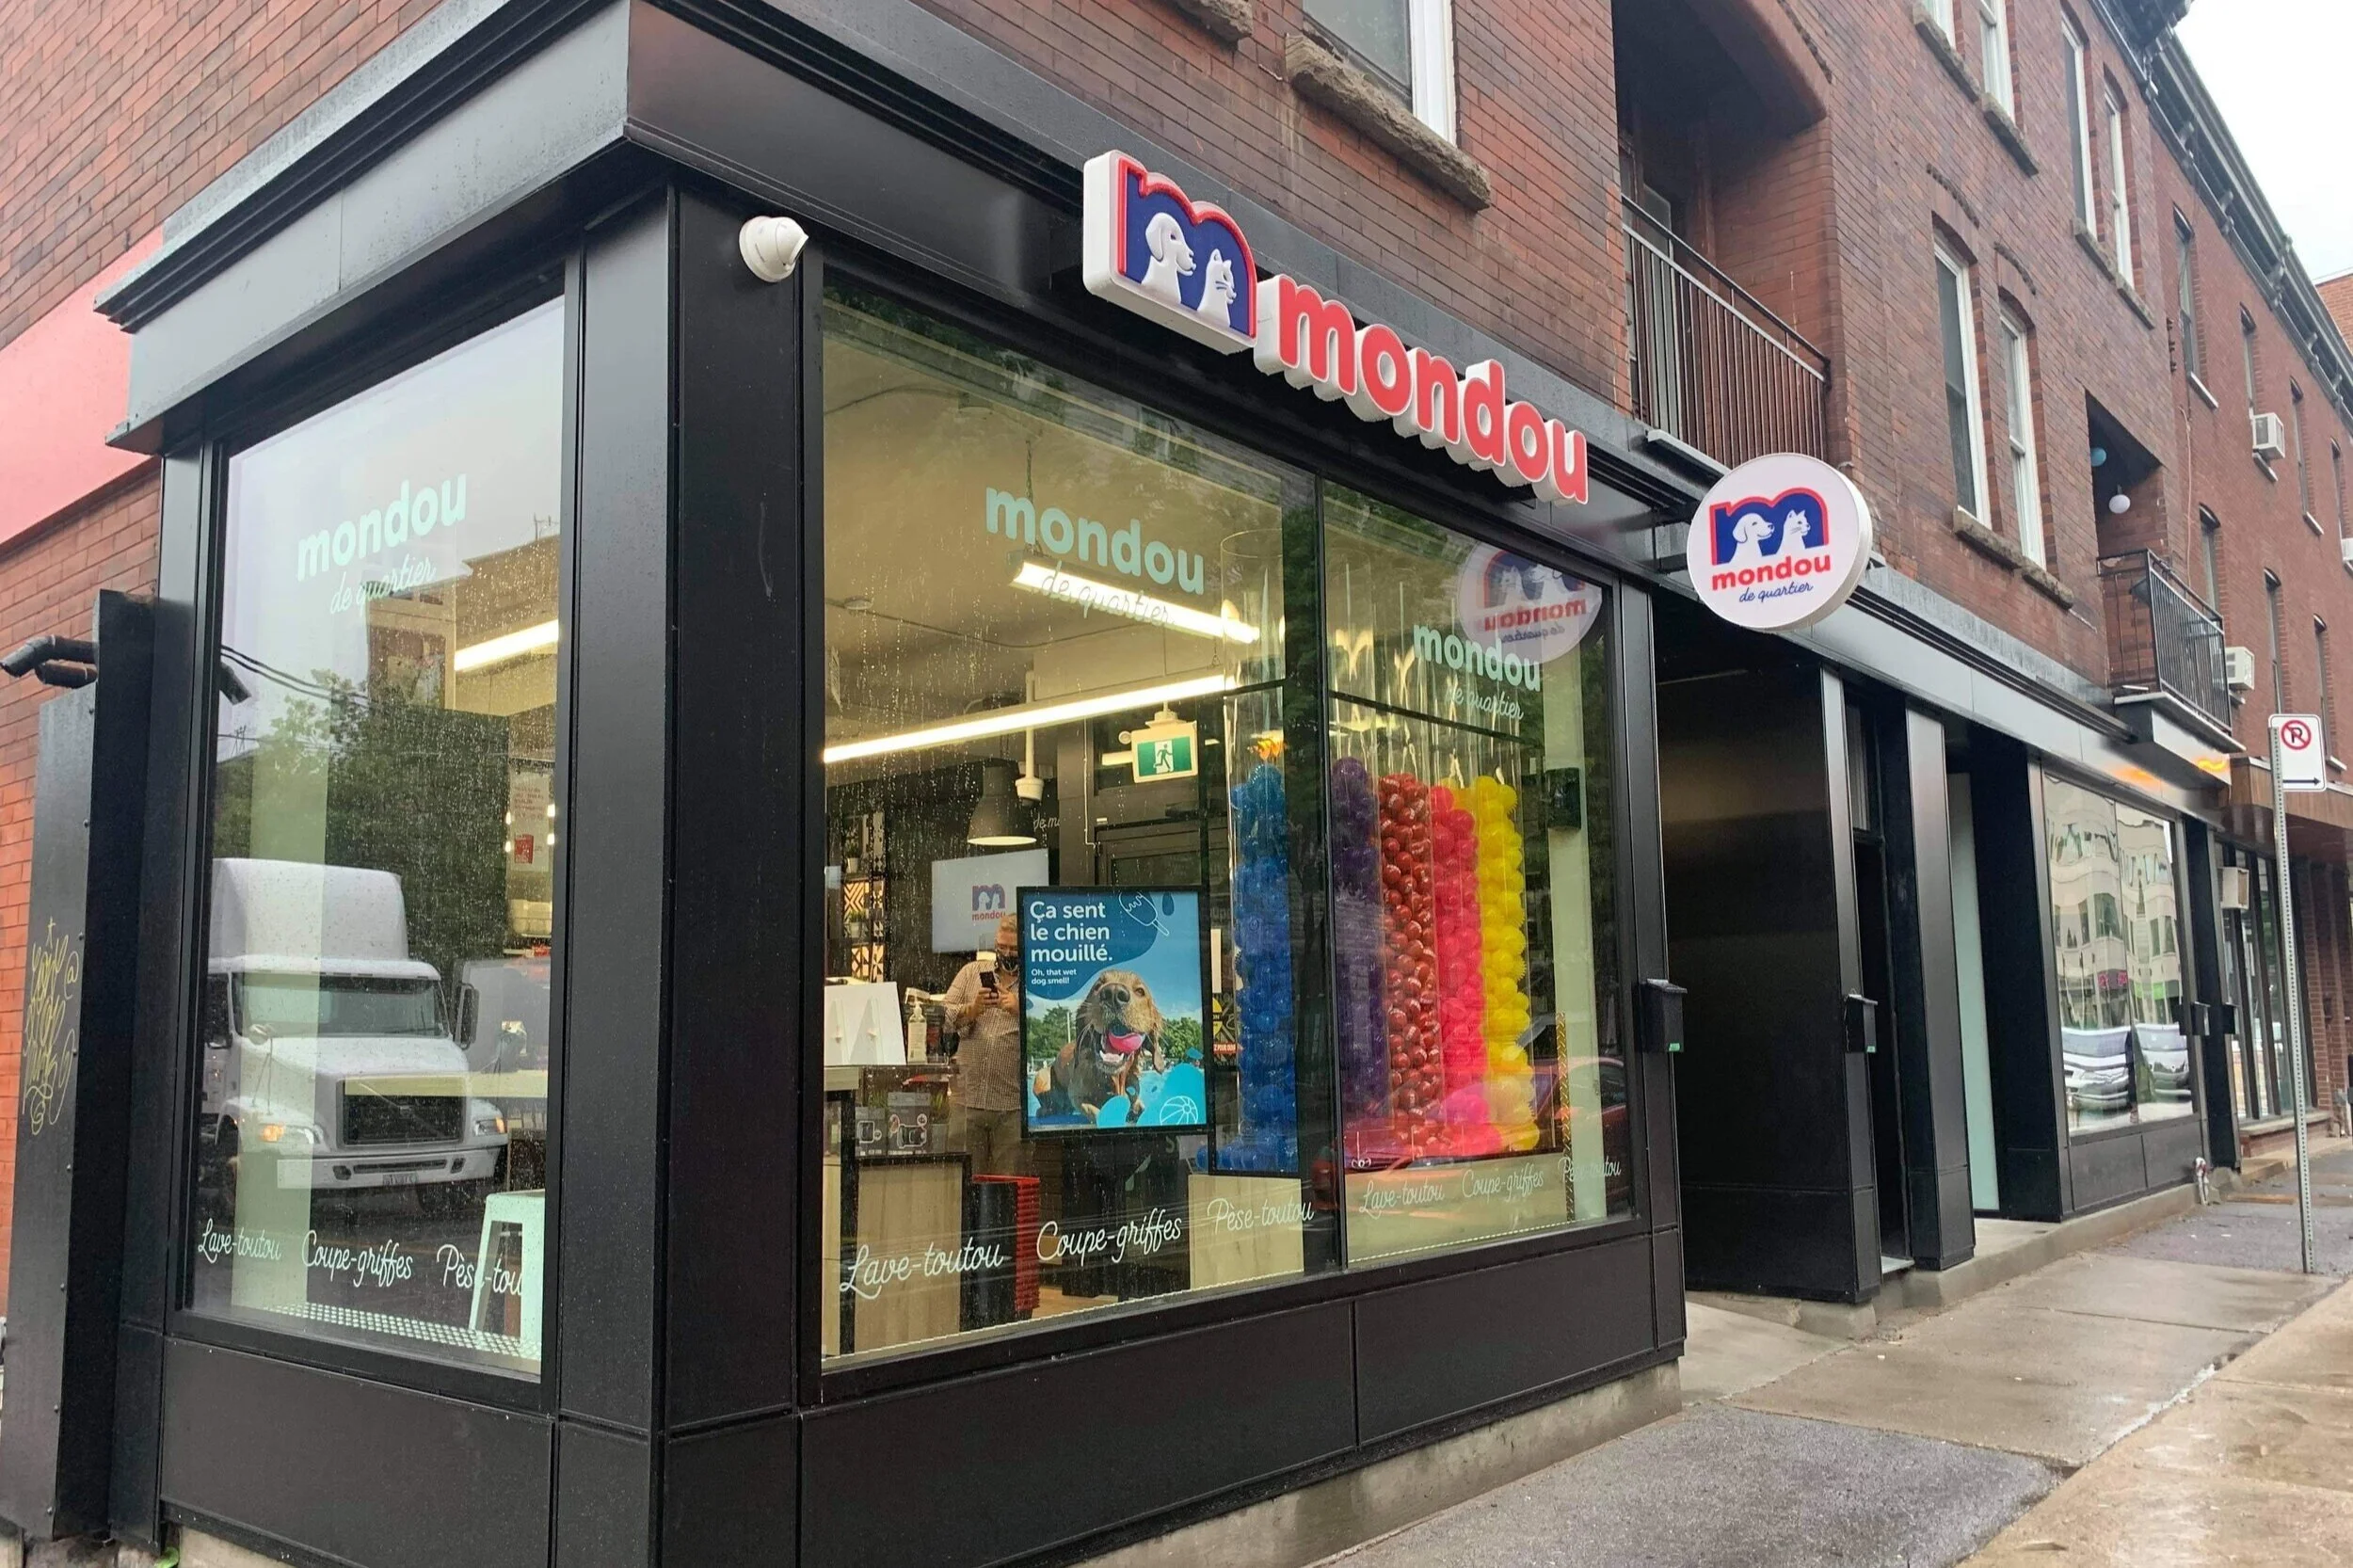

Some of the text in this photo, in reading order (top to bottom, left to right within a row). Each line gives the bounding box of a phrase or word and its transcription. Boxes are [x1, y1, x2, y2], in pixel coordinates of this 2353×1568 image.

[1278, 275, 1589, 504] mondou
[296, 473, 467, 583] mondou
[985, 487, 1204, 595] mondou
[330, 553, 438, 617] de quartier
[1041, 560, 1176, 627] de quartier
[1711, 554, 1832, 591] mondou
[1738, 581, 1815, 603] de quartier
[1413, 624, 1541, 692] mondou
[1030, 901, 1106, 923] Ça sent
[1030, 922, 1111, 941] le chien
[1031, 944, 1113, 963] mouillé.
[1031, 968, 1045, 977] Oh,
[1031, 976, 1070, 986] dog smell!
[1359, 1179, 1446, 1220] Lave-toutou
[1462, 1161, 1545, 1203] Coupe-griffes
[198, 1218, 281, 1264] Lave-toutou
[301, 1229, 414, 1288] Coupe-griffes
[840, 1197, 1315, 1300] Lave-toutou Coupe-griffes Pèse-toutou
